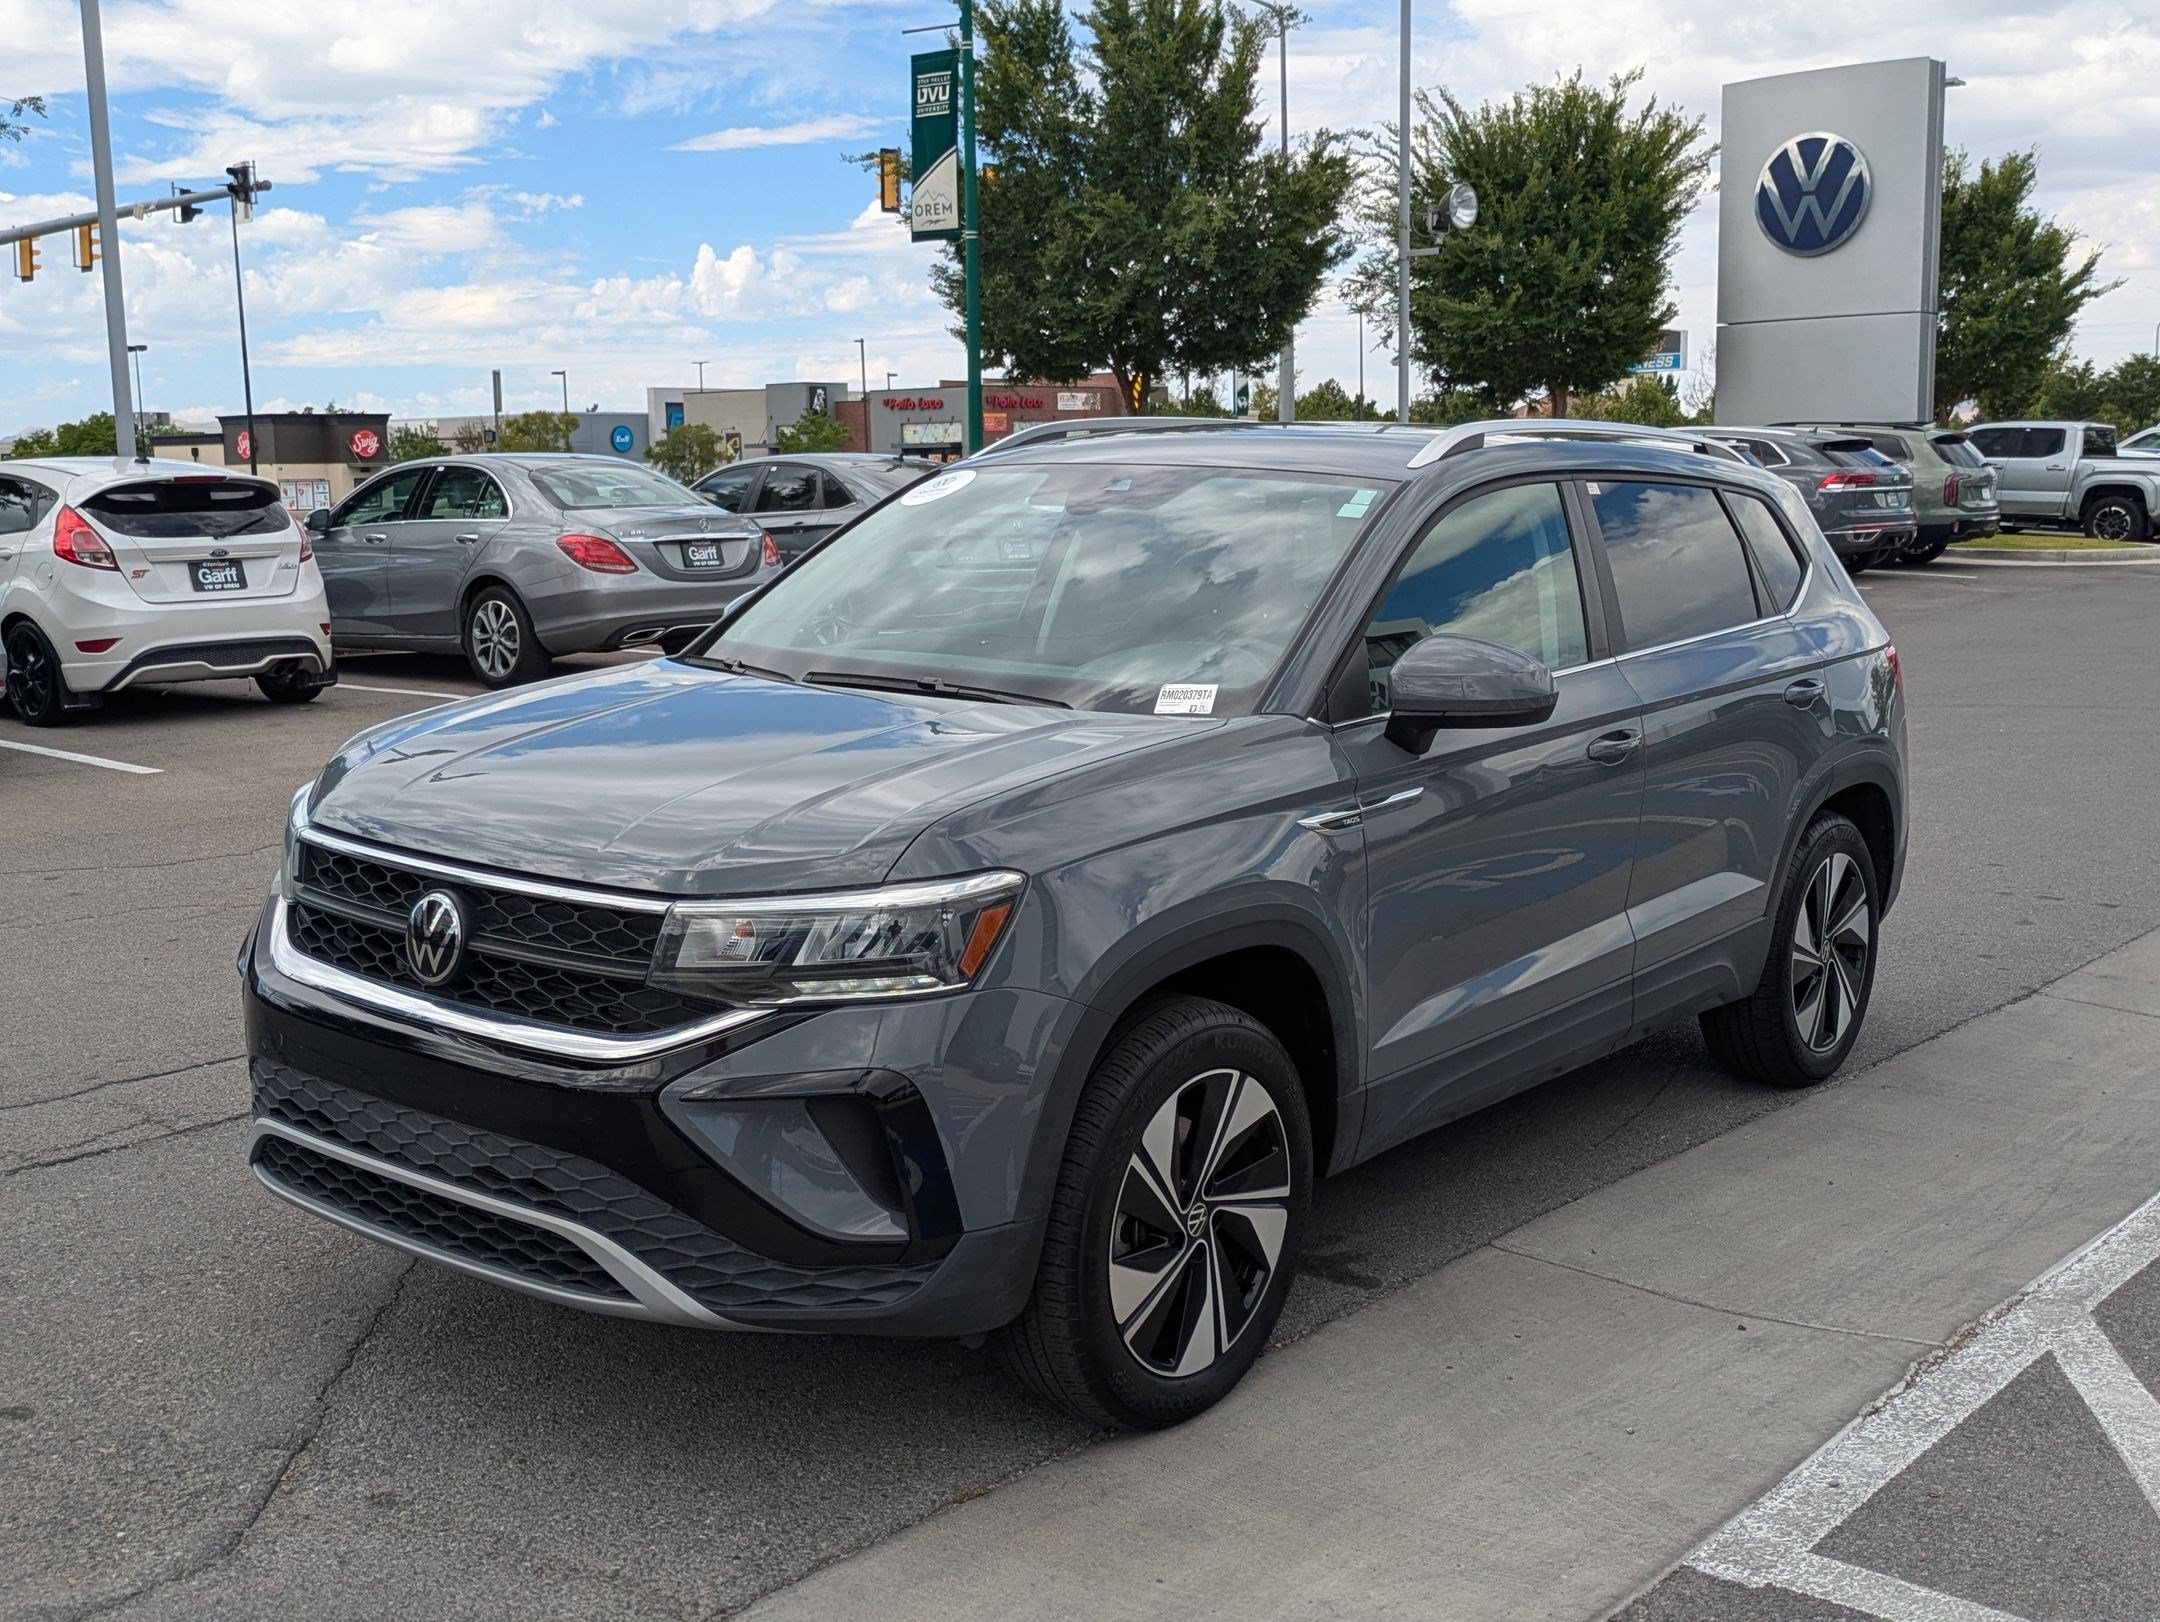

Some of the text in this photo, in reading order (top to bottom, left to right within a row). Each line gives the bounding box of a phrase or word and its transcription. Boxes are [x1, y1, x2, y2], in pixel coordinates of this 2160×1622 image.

[917, 85, 950, 104] UVU
[914, 202, 953, 217] OREM
[353, 434, 379, 453] Swig
[688, 546, 718, 560] Garff
[131, 569, 150, 579] ST
[198, 567, 238, 584] Garff
